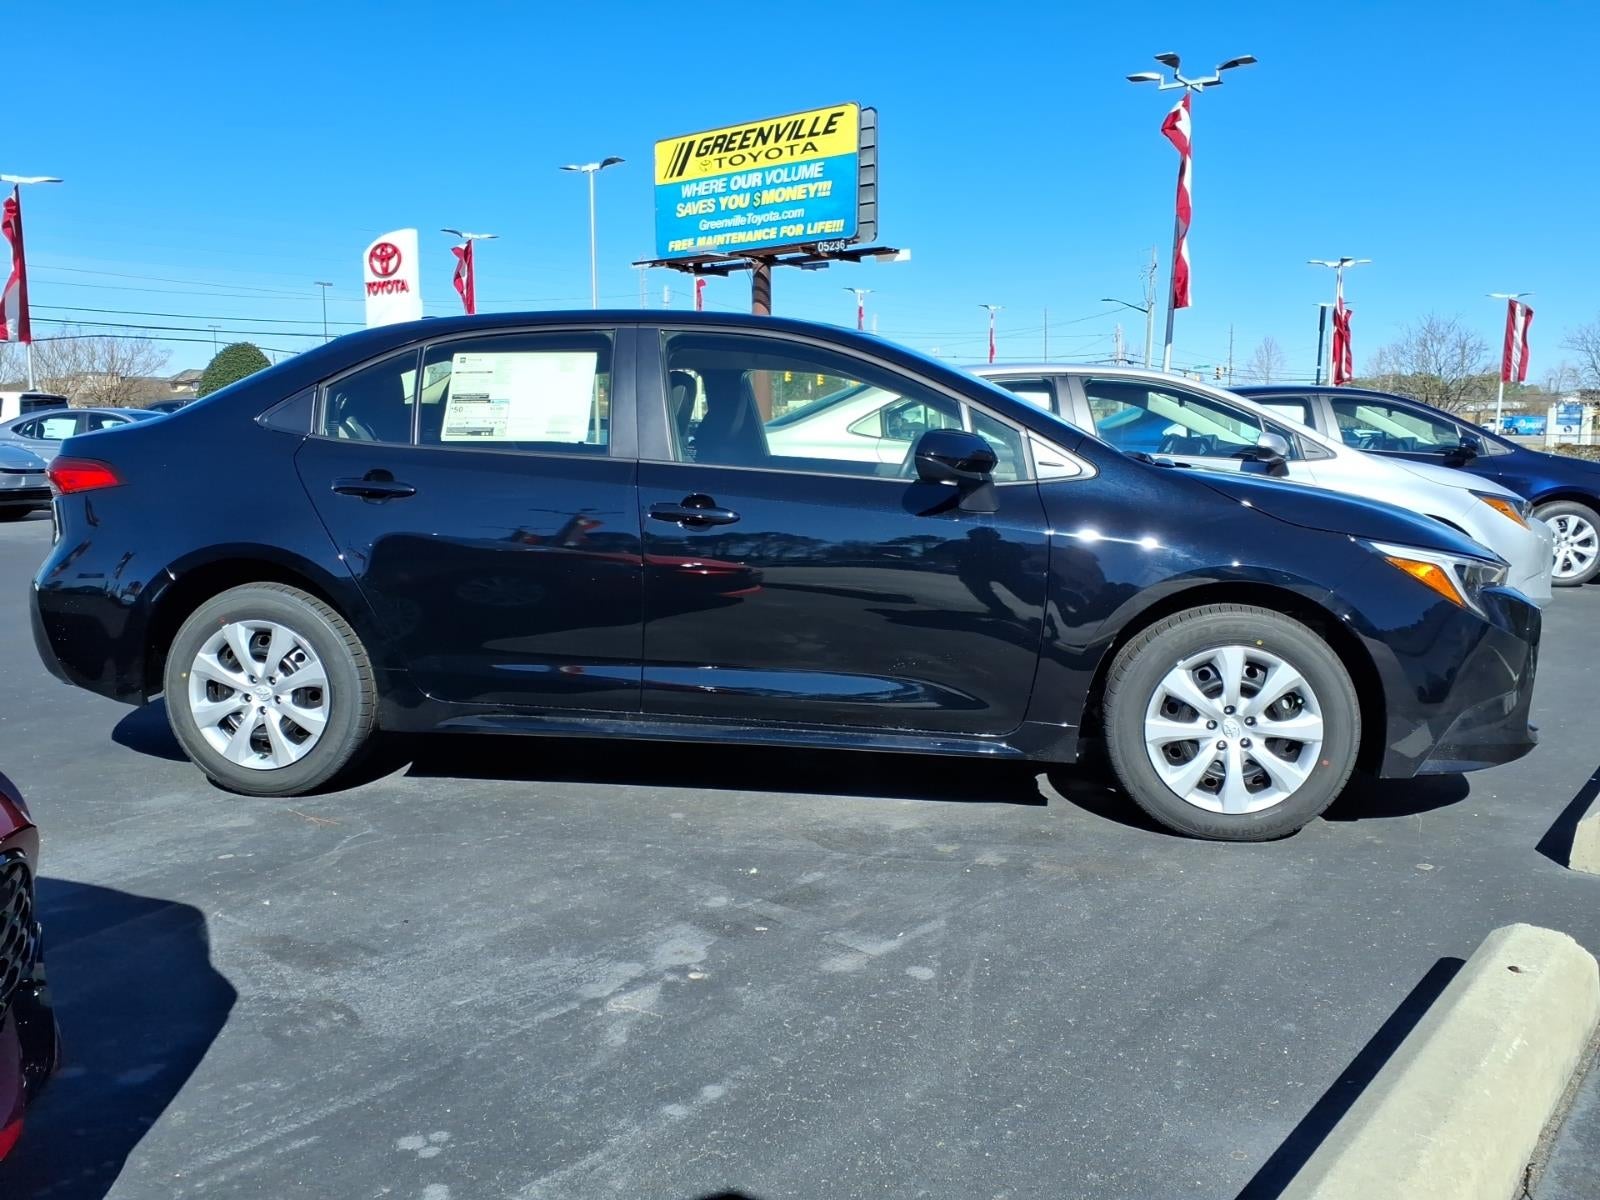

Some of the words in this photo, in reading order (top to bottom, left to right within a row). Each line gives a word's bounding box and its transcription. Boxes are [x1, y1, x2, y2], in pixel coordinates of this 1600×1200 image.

[695, 111, 845, 158] GREENVILLE
[714, 141, 818, 169] TOYOTA
[681, 178, 728, 198] WHERE
[730, 172, 763, 190] OUR
[765, 162, 824, 185] VOLUME
[676, 198, 716, 218] SAVES
[719, 193, 751, 211] YOU
[699, 208, 805, 231] GreenvilleToyota.com
[668, 238, 695, 252] FREE
[696, 227, 778, 247] MAINTENANCE
[780, 223, 805, 238] FOR
[806, 219, 845, 235] LIFE!!!
[817, 240, 846, 252] 05236
[365, 279, 409, 297] TOYOTA
